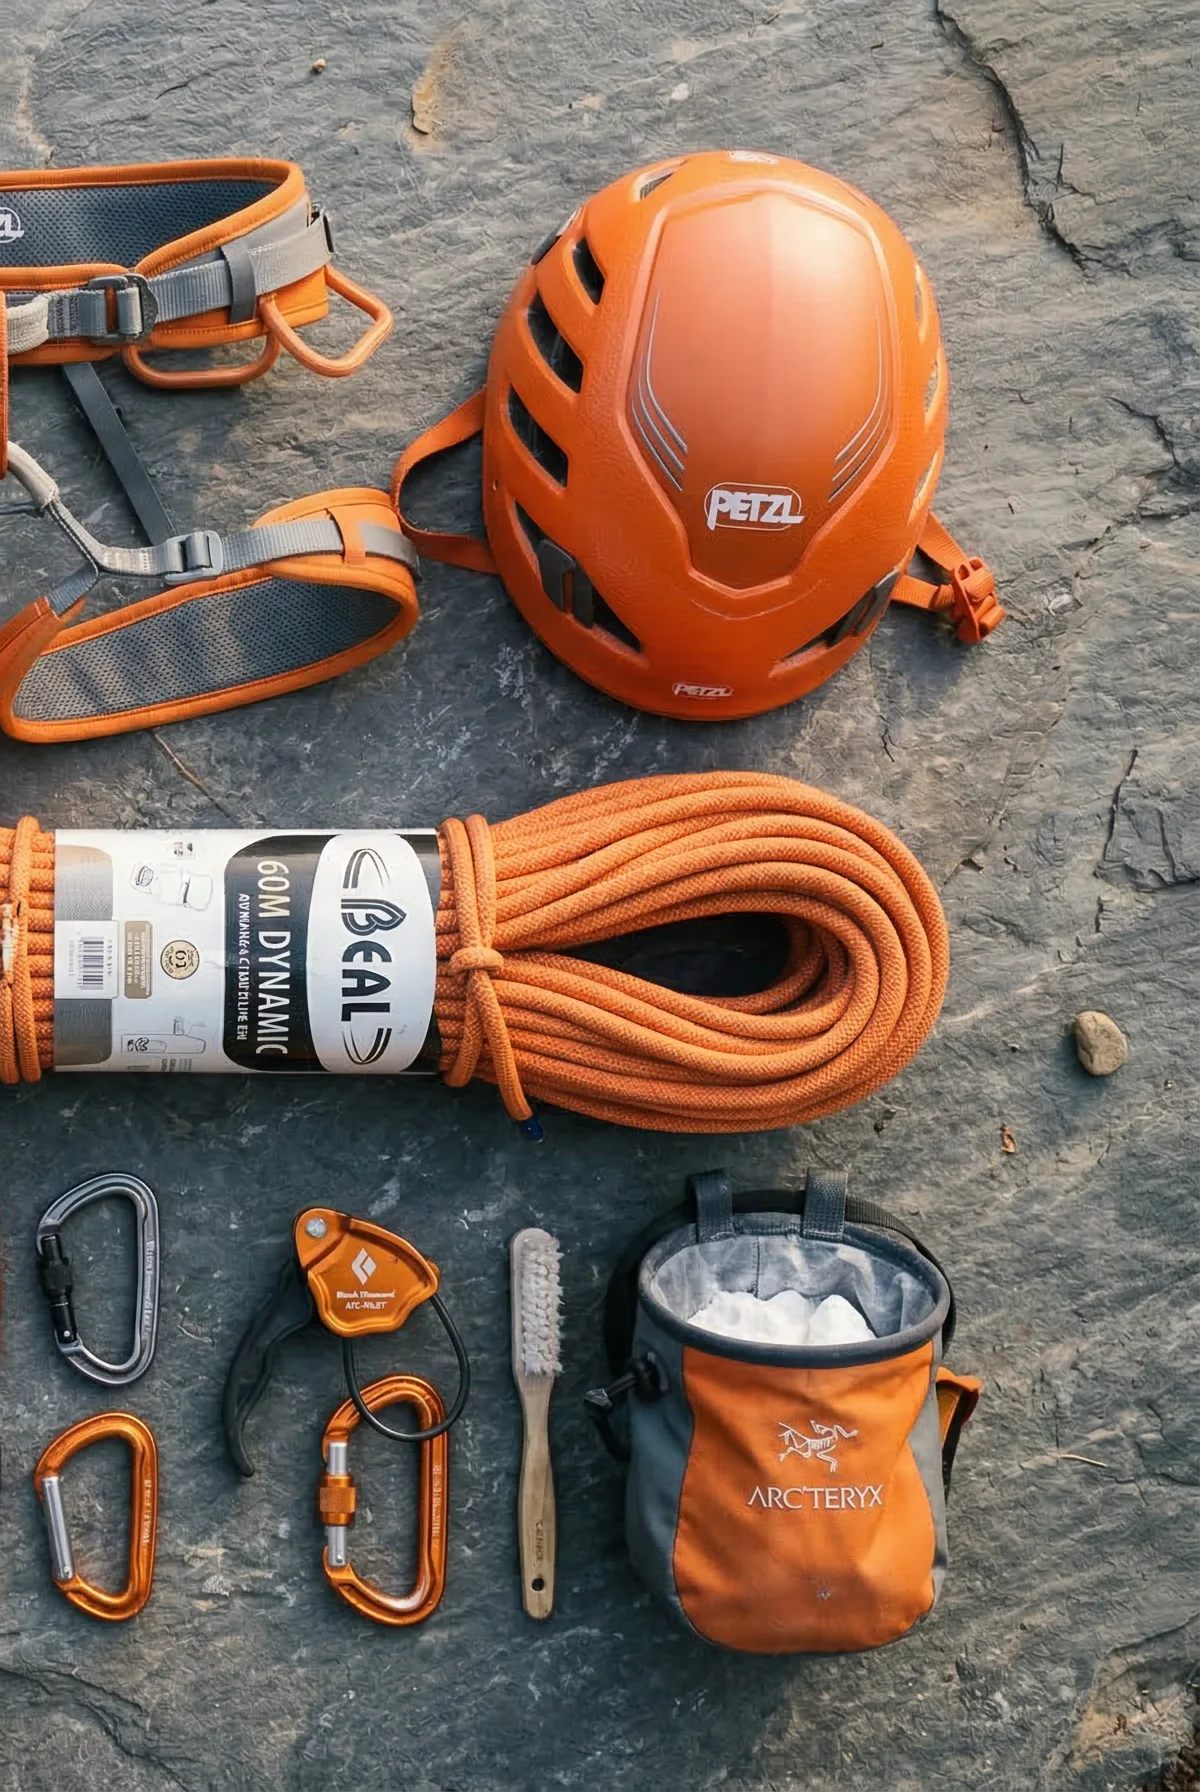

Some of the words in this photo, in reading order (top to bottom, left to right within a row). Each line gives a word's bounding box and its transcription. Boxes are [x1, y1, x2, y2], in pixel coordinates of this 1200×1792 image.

[706, 489, 805, 531] PETZL
[256, 859, 291, 918] 60M
[255, 930, 292, 1055] DYNAMIC
[340, 898, 408, 1022] BEAL
